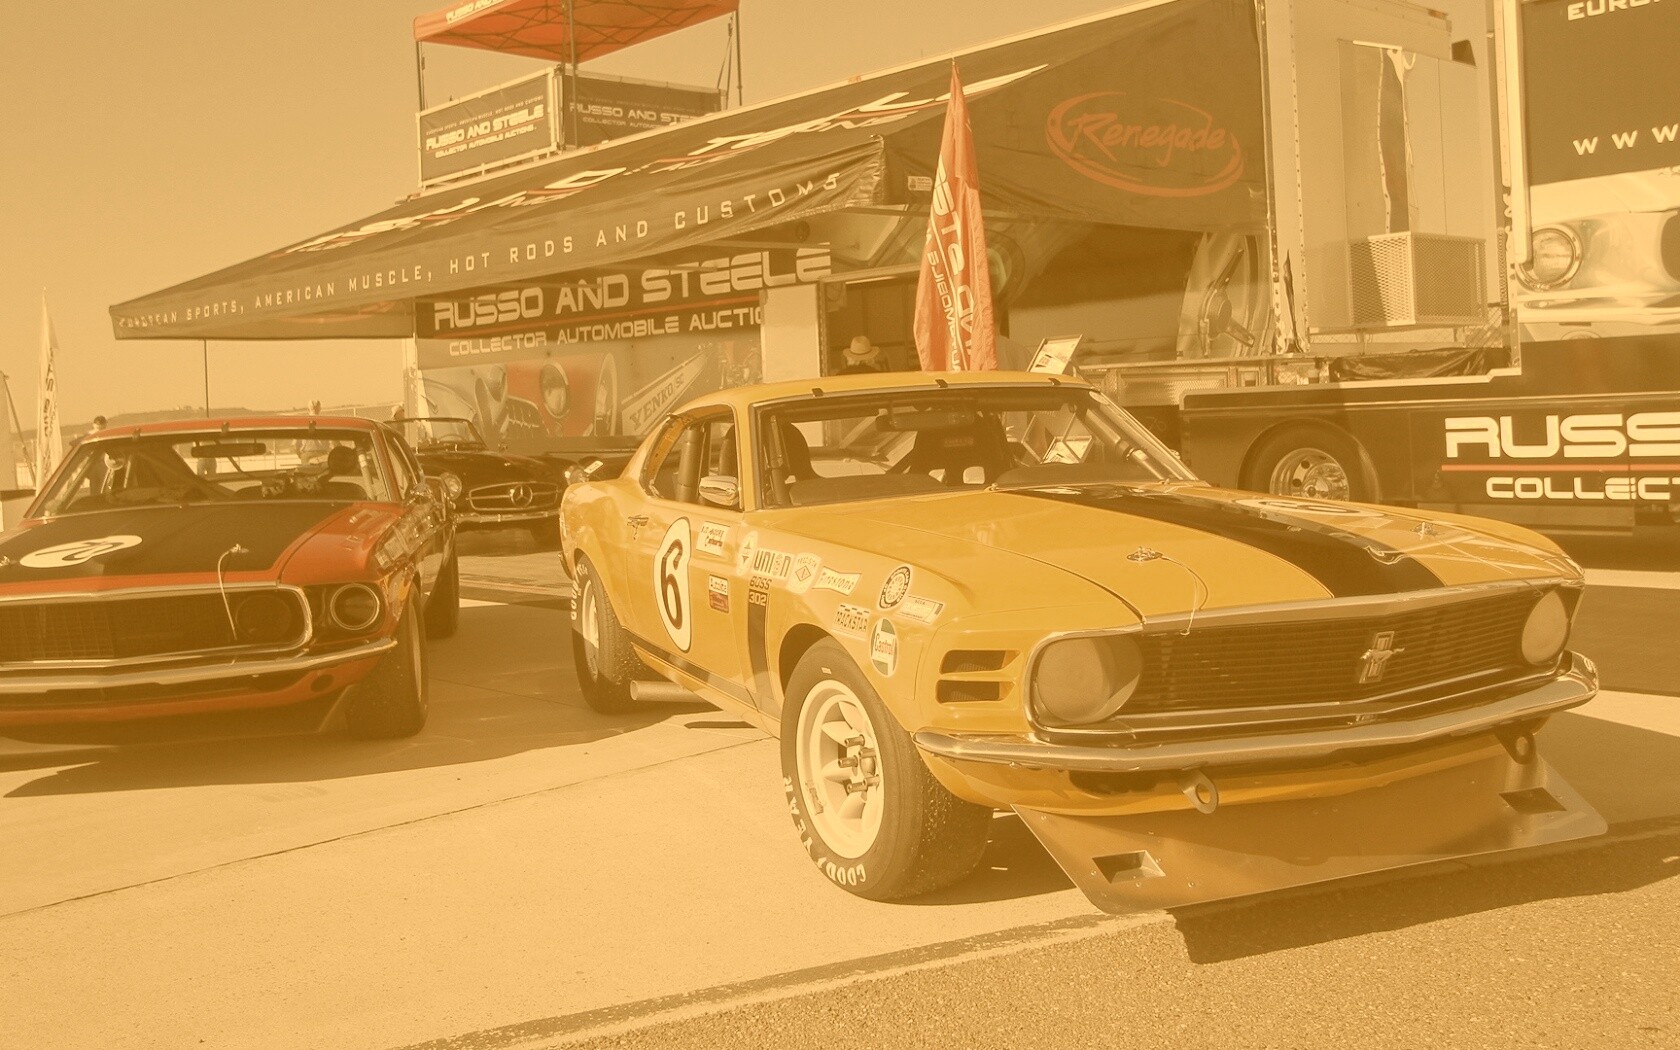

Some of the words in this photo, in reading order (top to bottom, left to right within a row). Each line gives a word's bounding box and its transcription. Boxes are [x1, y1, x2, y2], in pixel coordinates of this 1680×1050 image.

[426, 129, 465, 151] RUSSO
[467, 121, 491, 140] AND
[493, 104, 544, 131] STEELE
[628, 109, 657, 121] AND
[1067, 112, 1226, 167] Renegade
[186, 300, 244, 321] SPORTS,
[255, 282, 335, 310] AMERICAN
[348, 265, 434, 293] MUSCLE,
[449, 251, 491, 273] HOT
[509, 235, 574, 262] RODS
[596, 220, 650, 247] AND
[675, 172, 841, 230] CUSTOMS
[434, 286, 545, 331] RUSSO
[556, 274, 630, 315] AND
[641, 241, 832, 303] STEELE
[449, 331, 547, 357] COLLECTOR
[557, 315, 680, 346] AUTOMOBILE
[629, 383, 674, 431] YENKO
[660, 538, 683, 630] 6
[748, 590, 767, 606] 302
[750, 575, 772, 590] BOSS
[834, 610, 868, 632] TRACKSTAR
[875, 632, 896, 656] Castrol
